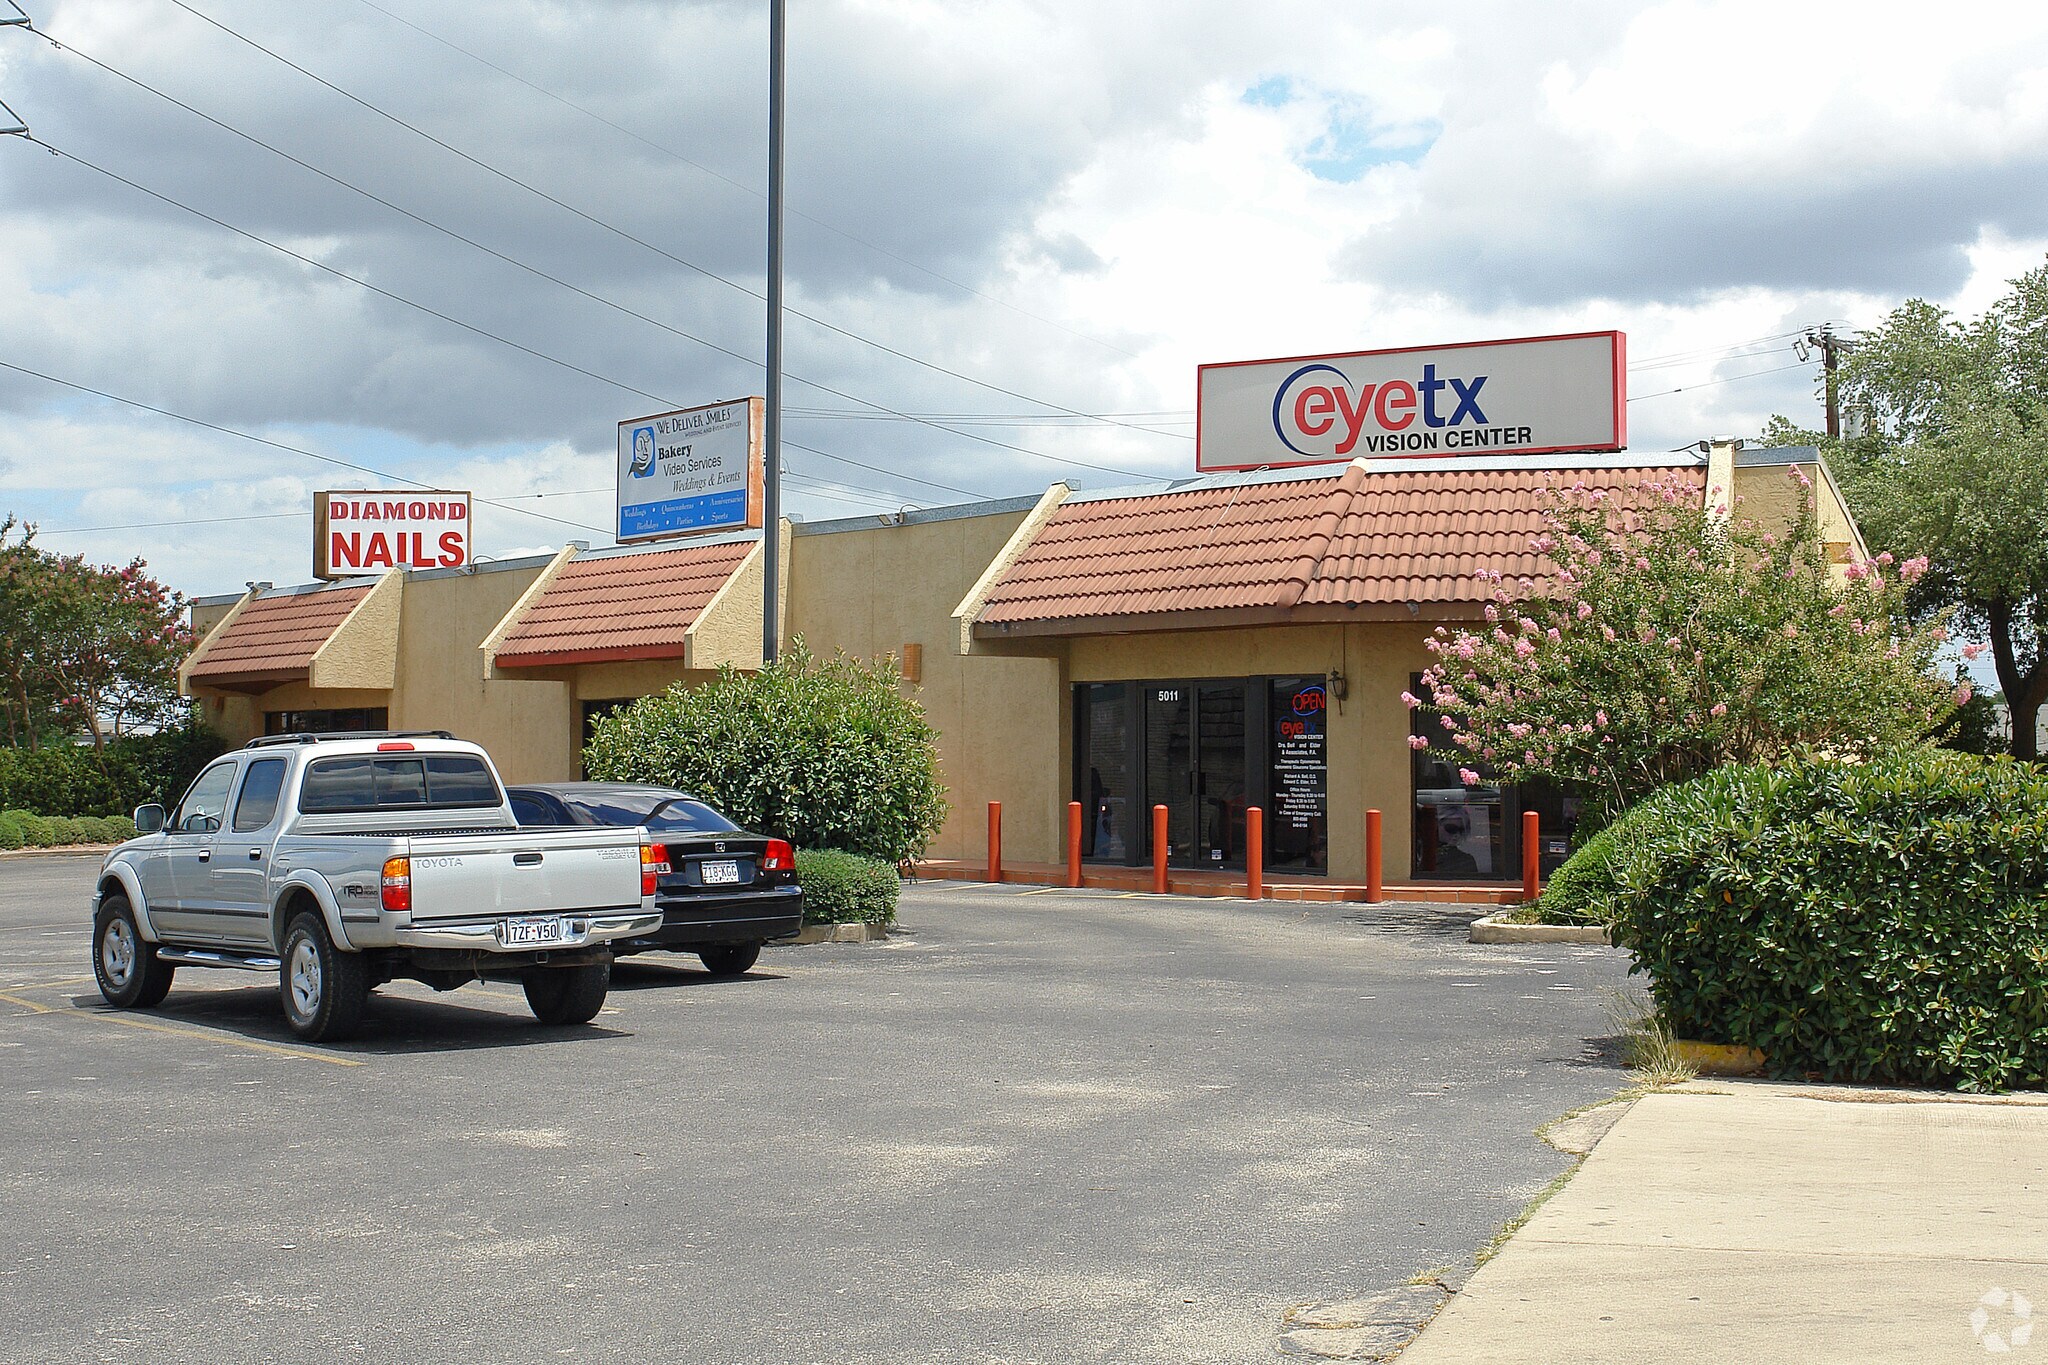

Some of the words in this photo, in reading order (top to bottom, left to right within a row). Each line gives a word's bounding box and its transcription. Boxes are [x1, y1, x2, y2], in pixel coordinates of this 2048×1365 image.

[1293, 363, 1489, 455] eyetx
[656, 419, 671, 434] WE
[672, 414, 704, 433] DELIVER
[706, 408, 731, 425] SMILES
[1365, 432, 1439, 453] VISION
[1444, 426, 1533, 448] CENTER
[658, 444, 692, 460] Bakery
[663, 462, 687, 477] Video
[687, 456, 722, 472] Services
[673, 477, 706, 493] Weddings
[708, 475, 715, 486] &
[717, 470, 741, 485] Events
[330, 501, 466, 521] DIAMOND
[676, 516, 694, 526] Parties
[711, 511, 728, 522] Sports
[331, 531, 465, 568] NAILS
[1158, 690, 1178, 701] 5011
[1292, 693, 1325, 710] OPEN
[414, 857, 463, 869] TOYOTA
